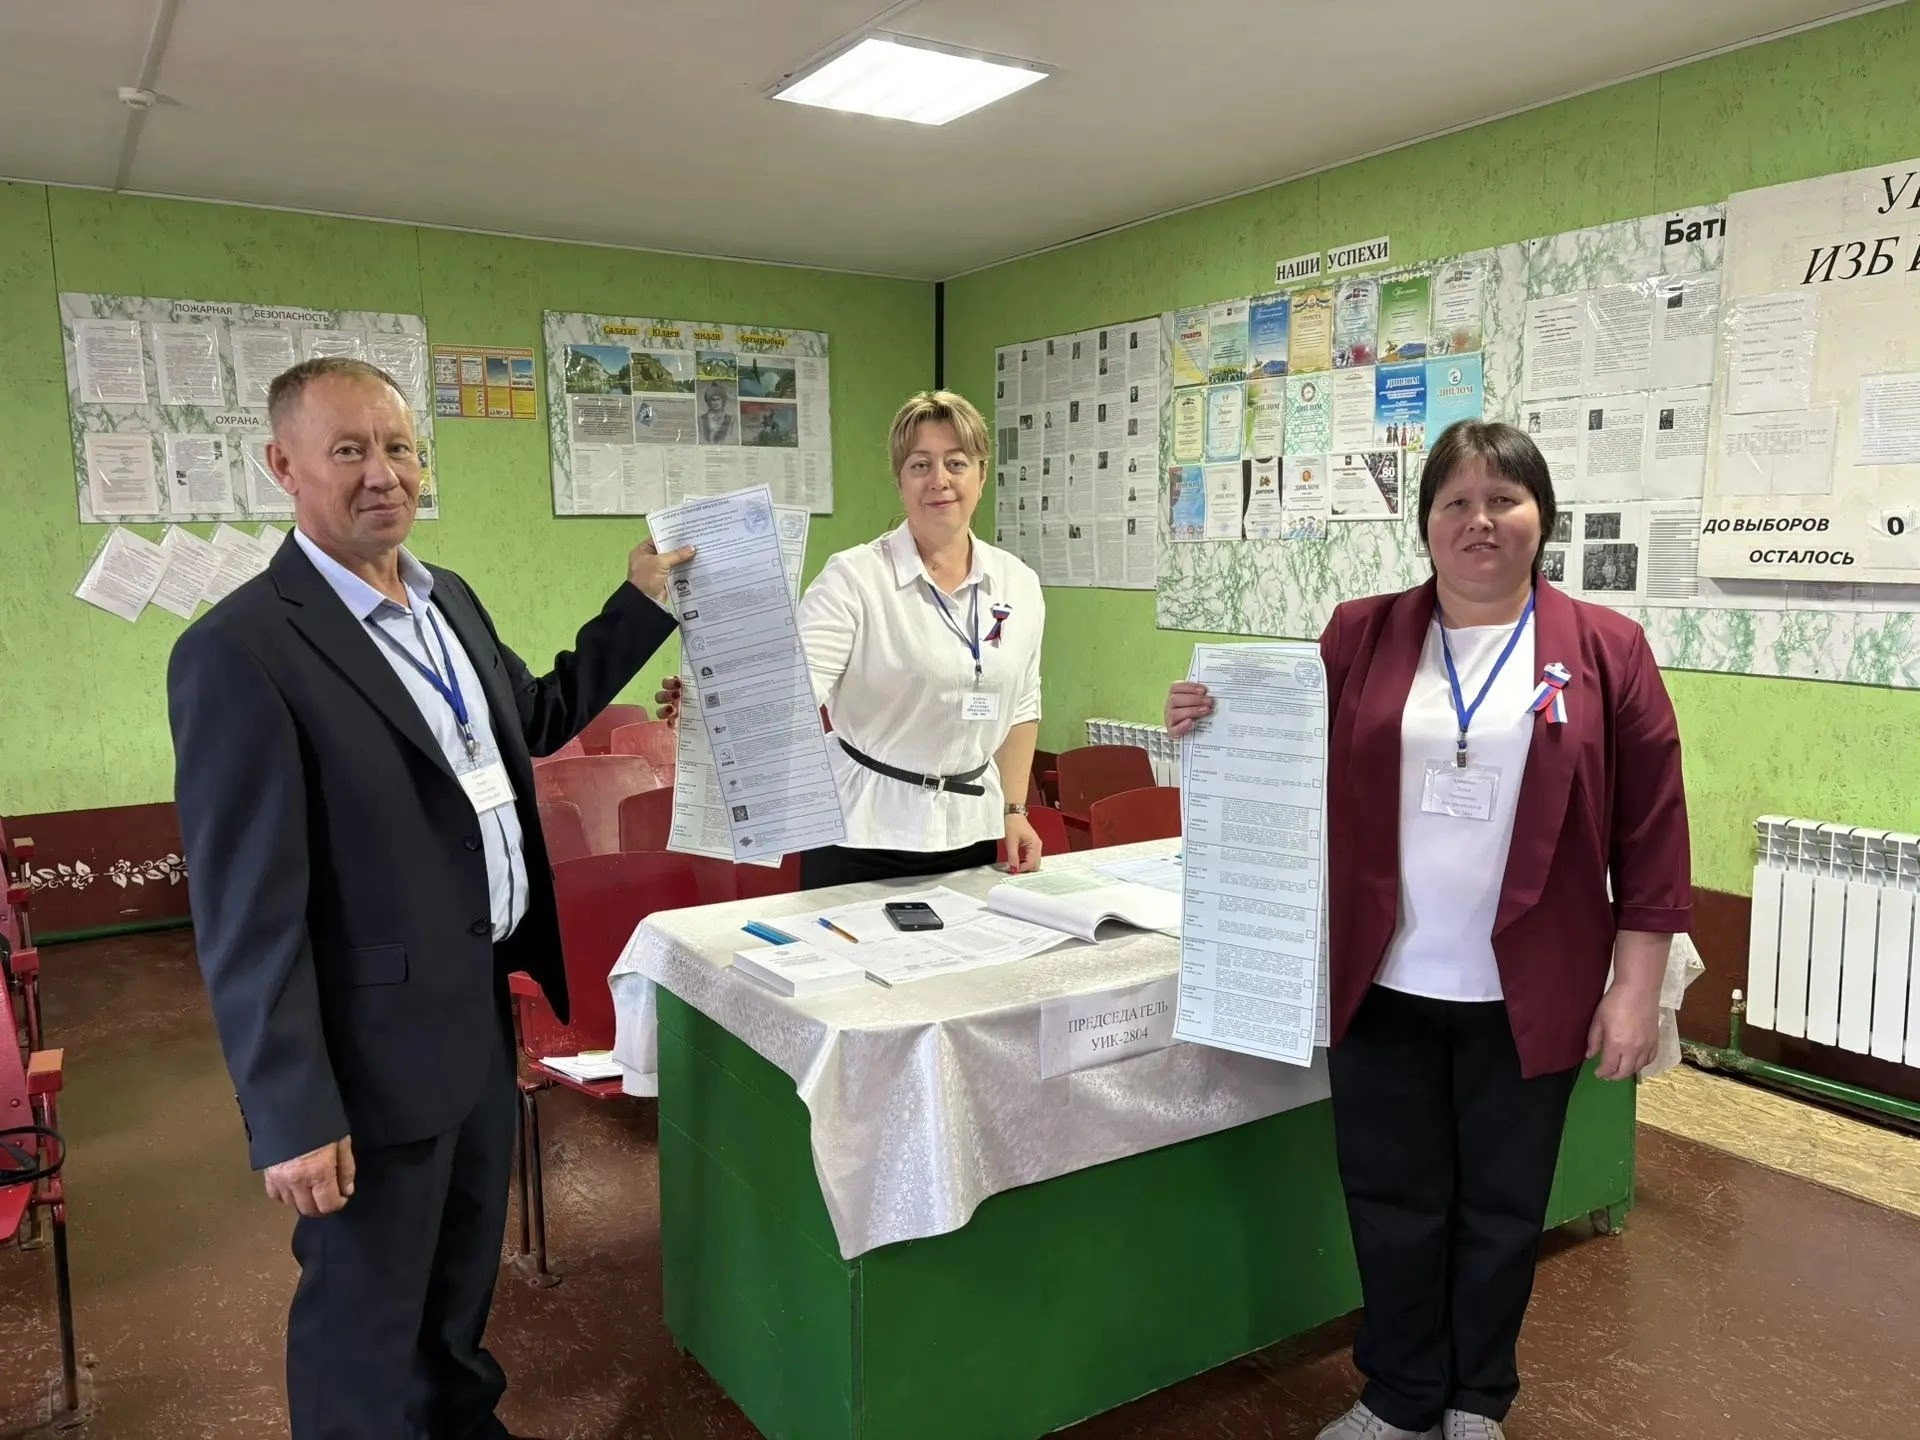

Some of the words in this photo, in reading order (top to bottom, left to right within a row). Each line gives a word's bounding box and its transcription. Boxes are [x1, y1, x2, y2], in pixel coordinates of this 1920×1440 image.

[1276, 256, 1320, 281] НАШИ
[1327, 242, 1389, 270] УСПЕХИ
[174, 303, 233, 315] ПОЖАРНАЯ
[254, 309, 330, 322] БЕЗОПАСНОСТЬ
[603, 325, 637, 336] Салауат
[215, 415, 259, 425] ОХРАНА
[1382, 467, 1395, 478] 80
[1702, 518, 1730, 534] ДО
[1733, 518, 1830, 532] ВЫБОРОВ
[1887, 516, 1905, 536] 0
[1749, 549, 1855, 565] ОСТАЛОСЬ
[1068, 1000, 1168, 1033] ПРЕДСЕДАТЕЛЬ
[1091, 1026, 1149, 1051] УИК-2804
